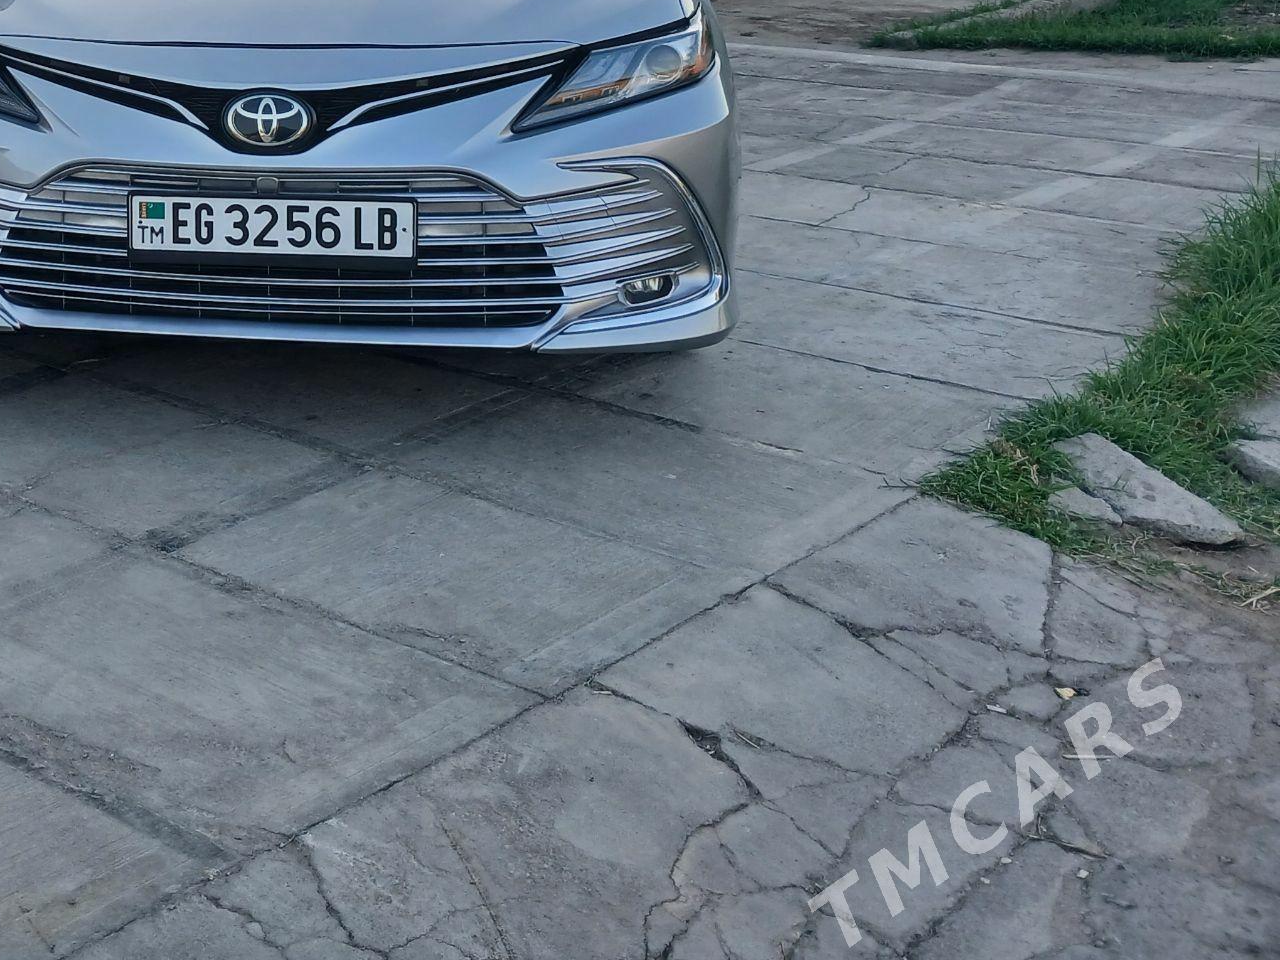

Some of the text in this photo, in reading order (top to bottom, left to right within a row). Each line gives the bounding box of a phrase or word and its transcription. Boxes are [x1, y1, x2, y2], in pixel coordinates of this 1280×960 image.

[137, 225, 164, 244] TM
[172, 202, 398, 250] EG 3256 LB
